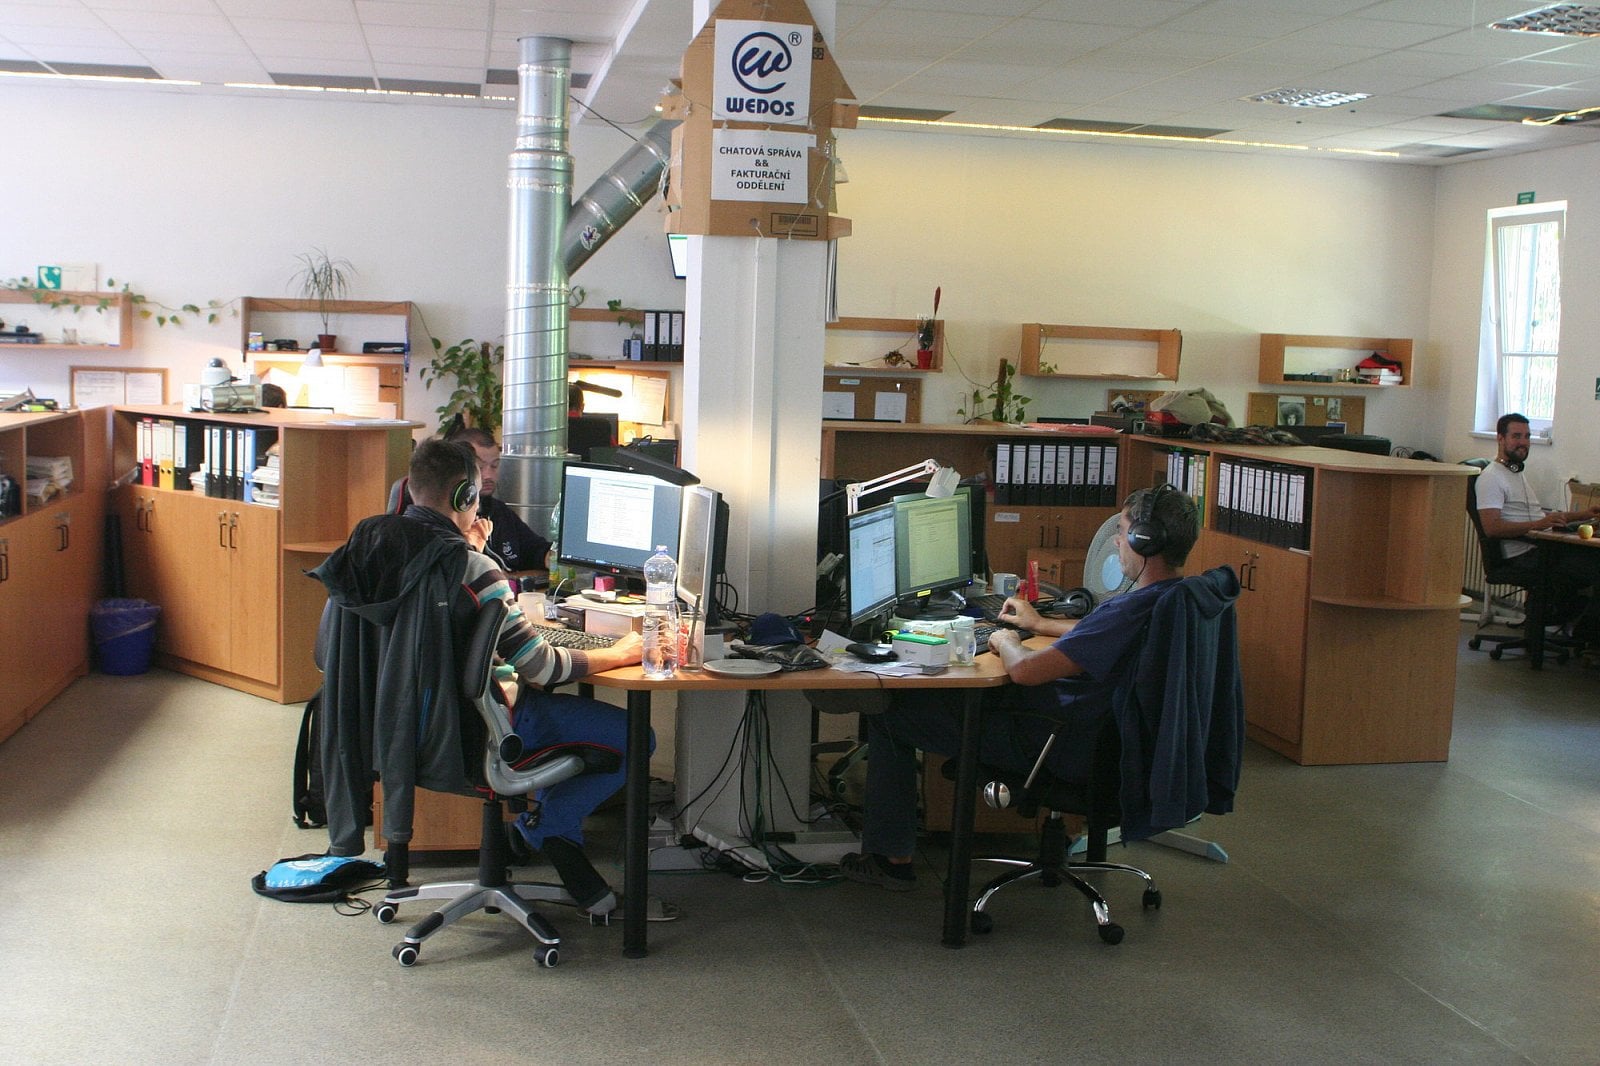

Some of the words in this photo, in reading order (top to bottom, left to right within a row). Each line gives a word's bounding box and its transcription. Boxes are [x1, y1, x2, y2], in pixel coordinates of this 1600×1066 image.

[726, 97, 795, 116] WEDOS
[719, 145, 765, 156] CHATOVÁ
[767, 147, 802, 158] SPRÁVA
[754, 159, 769, 167] &&
[731, 168, 791, 180] FAKTURAČNÍ
[736, 180, 785, 191] ODDĚLENÍ
